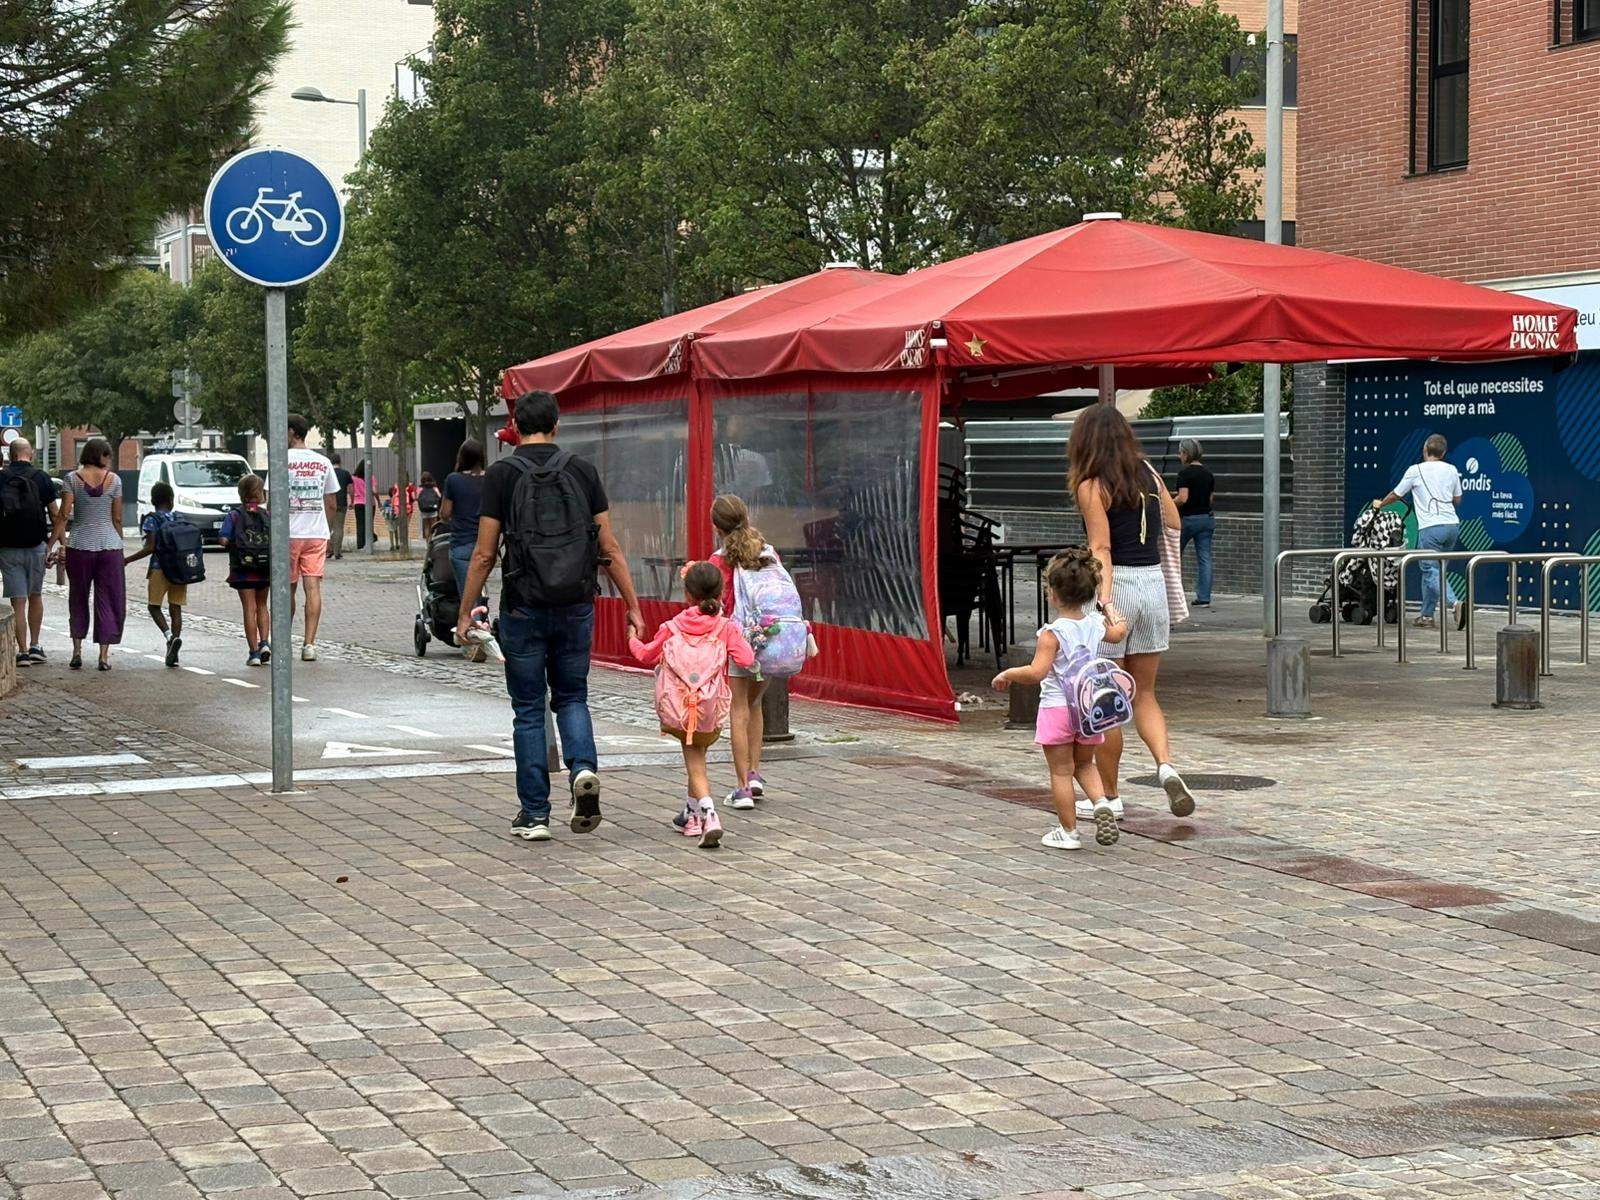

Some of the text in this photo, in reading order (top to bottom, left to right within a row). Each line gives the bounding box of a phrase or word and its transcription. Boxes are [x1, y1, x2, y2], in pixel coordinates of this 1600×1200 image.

[1512, 314, 1558, 332] HOME
[1577, 311, 1596, 326] eu
[1509, 331, 1560, 350] PICNIC
[1424, 376, 1544, 398] Tot el que necessites
[1423, 399, 1495, 419] sempre a mà
